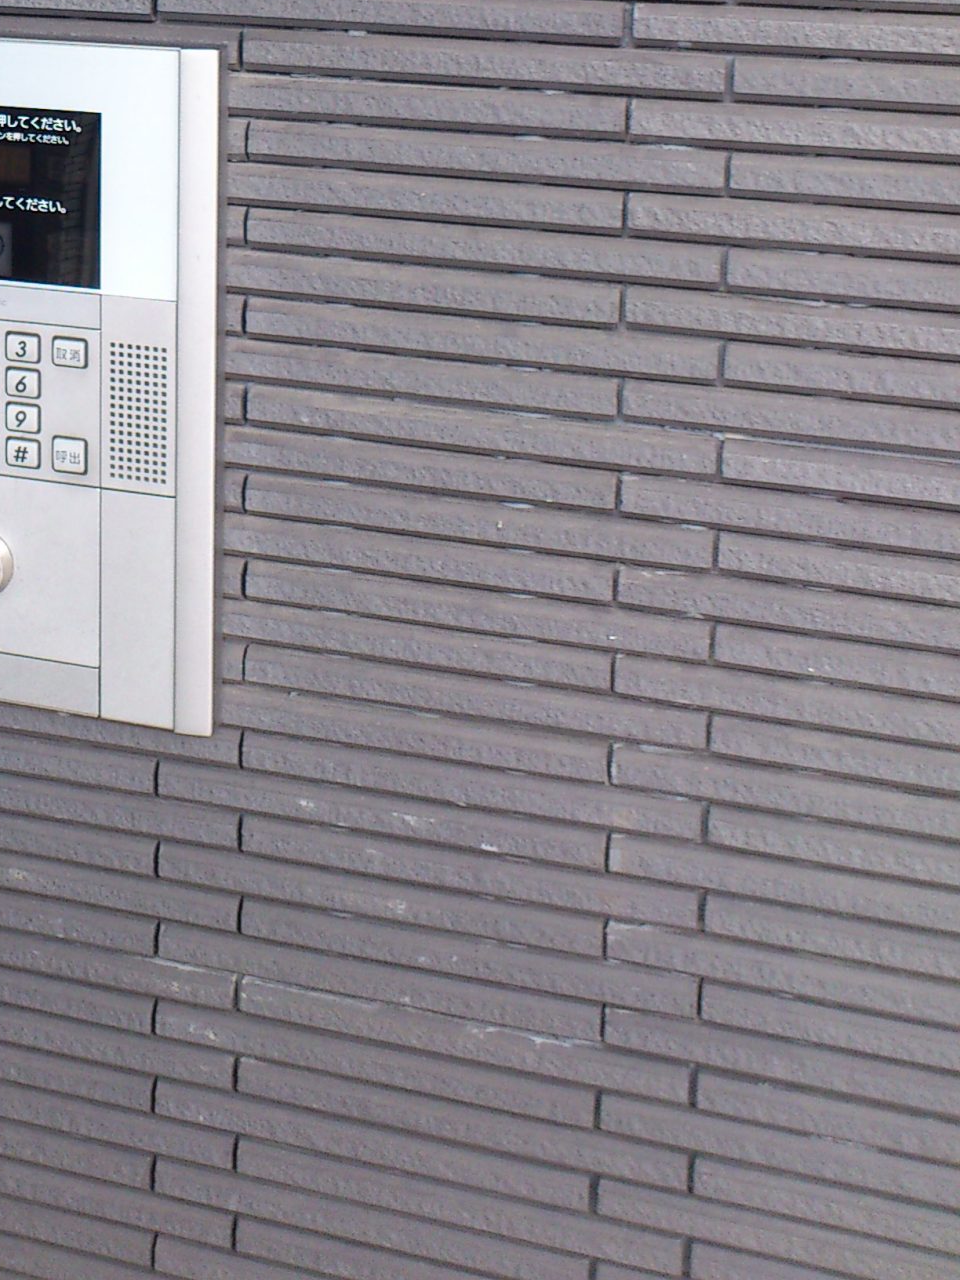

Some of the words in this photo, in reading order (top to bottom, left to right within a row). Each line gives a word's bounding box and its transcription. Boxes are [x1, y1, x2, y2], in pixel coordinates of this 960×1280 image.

[16, 341, 27, 357] 3
[56, 347, 80, 362] 取消
[16, 376, 27, 393] 6
[16, 411, 27, 427] 9
[56, 450, 80, 465] 呼出
